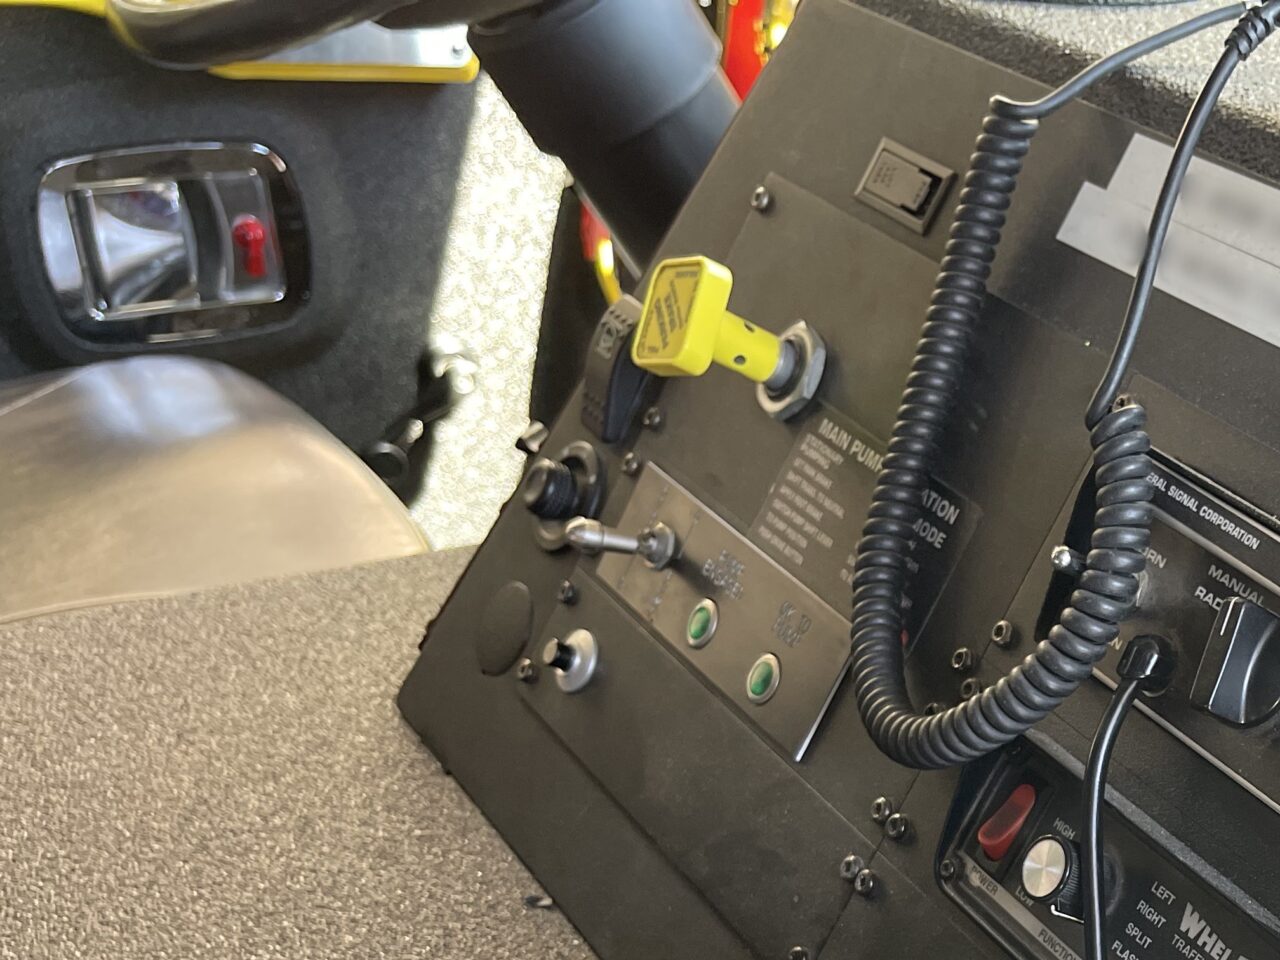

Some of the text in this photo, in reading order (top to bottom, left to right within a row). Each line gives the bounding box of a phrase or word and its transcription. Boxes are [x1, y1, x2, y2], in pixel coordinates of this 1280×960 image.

[819, 418, 852, 451] MAIN
[922, 488, 960, 525] ATION
[1146, 472, 1262, 550] ERAL SIGNAL CORPORATION
[1194, 586, 1224, 612] RAD
[1052, 817, 1077, 839] HIGH
[1151, 881, 1177, 906] LEFT
[1136, 900, 1167, 929] RIGHT
[1125, 922, 1153, 950] SPLIT
